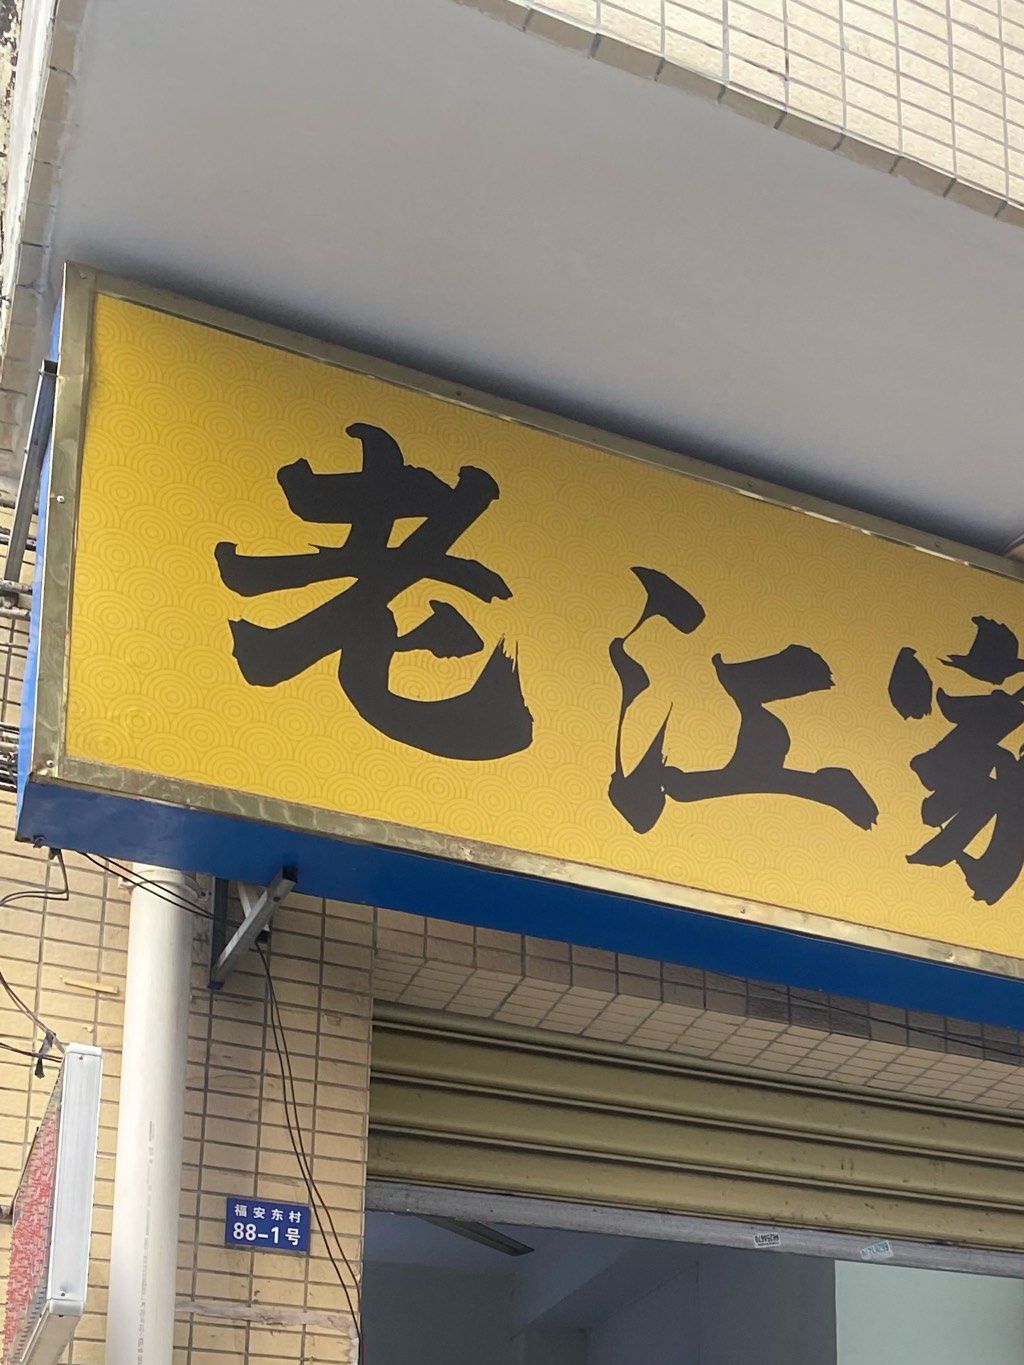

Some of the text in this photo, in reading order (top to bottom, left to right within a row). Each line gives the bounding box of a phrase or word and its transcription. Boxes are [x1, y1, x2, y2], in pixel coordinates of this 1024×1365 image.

[234, 1204, 301, 1223] 福安东村
[233, 1222, 301, 1246] 88-1号
